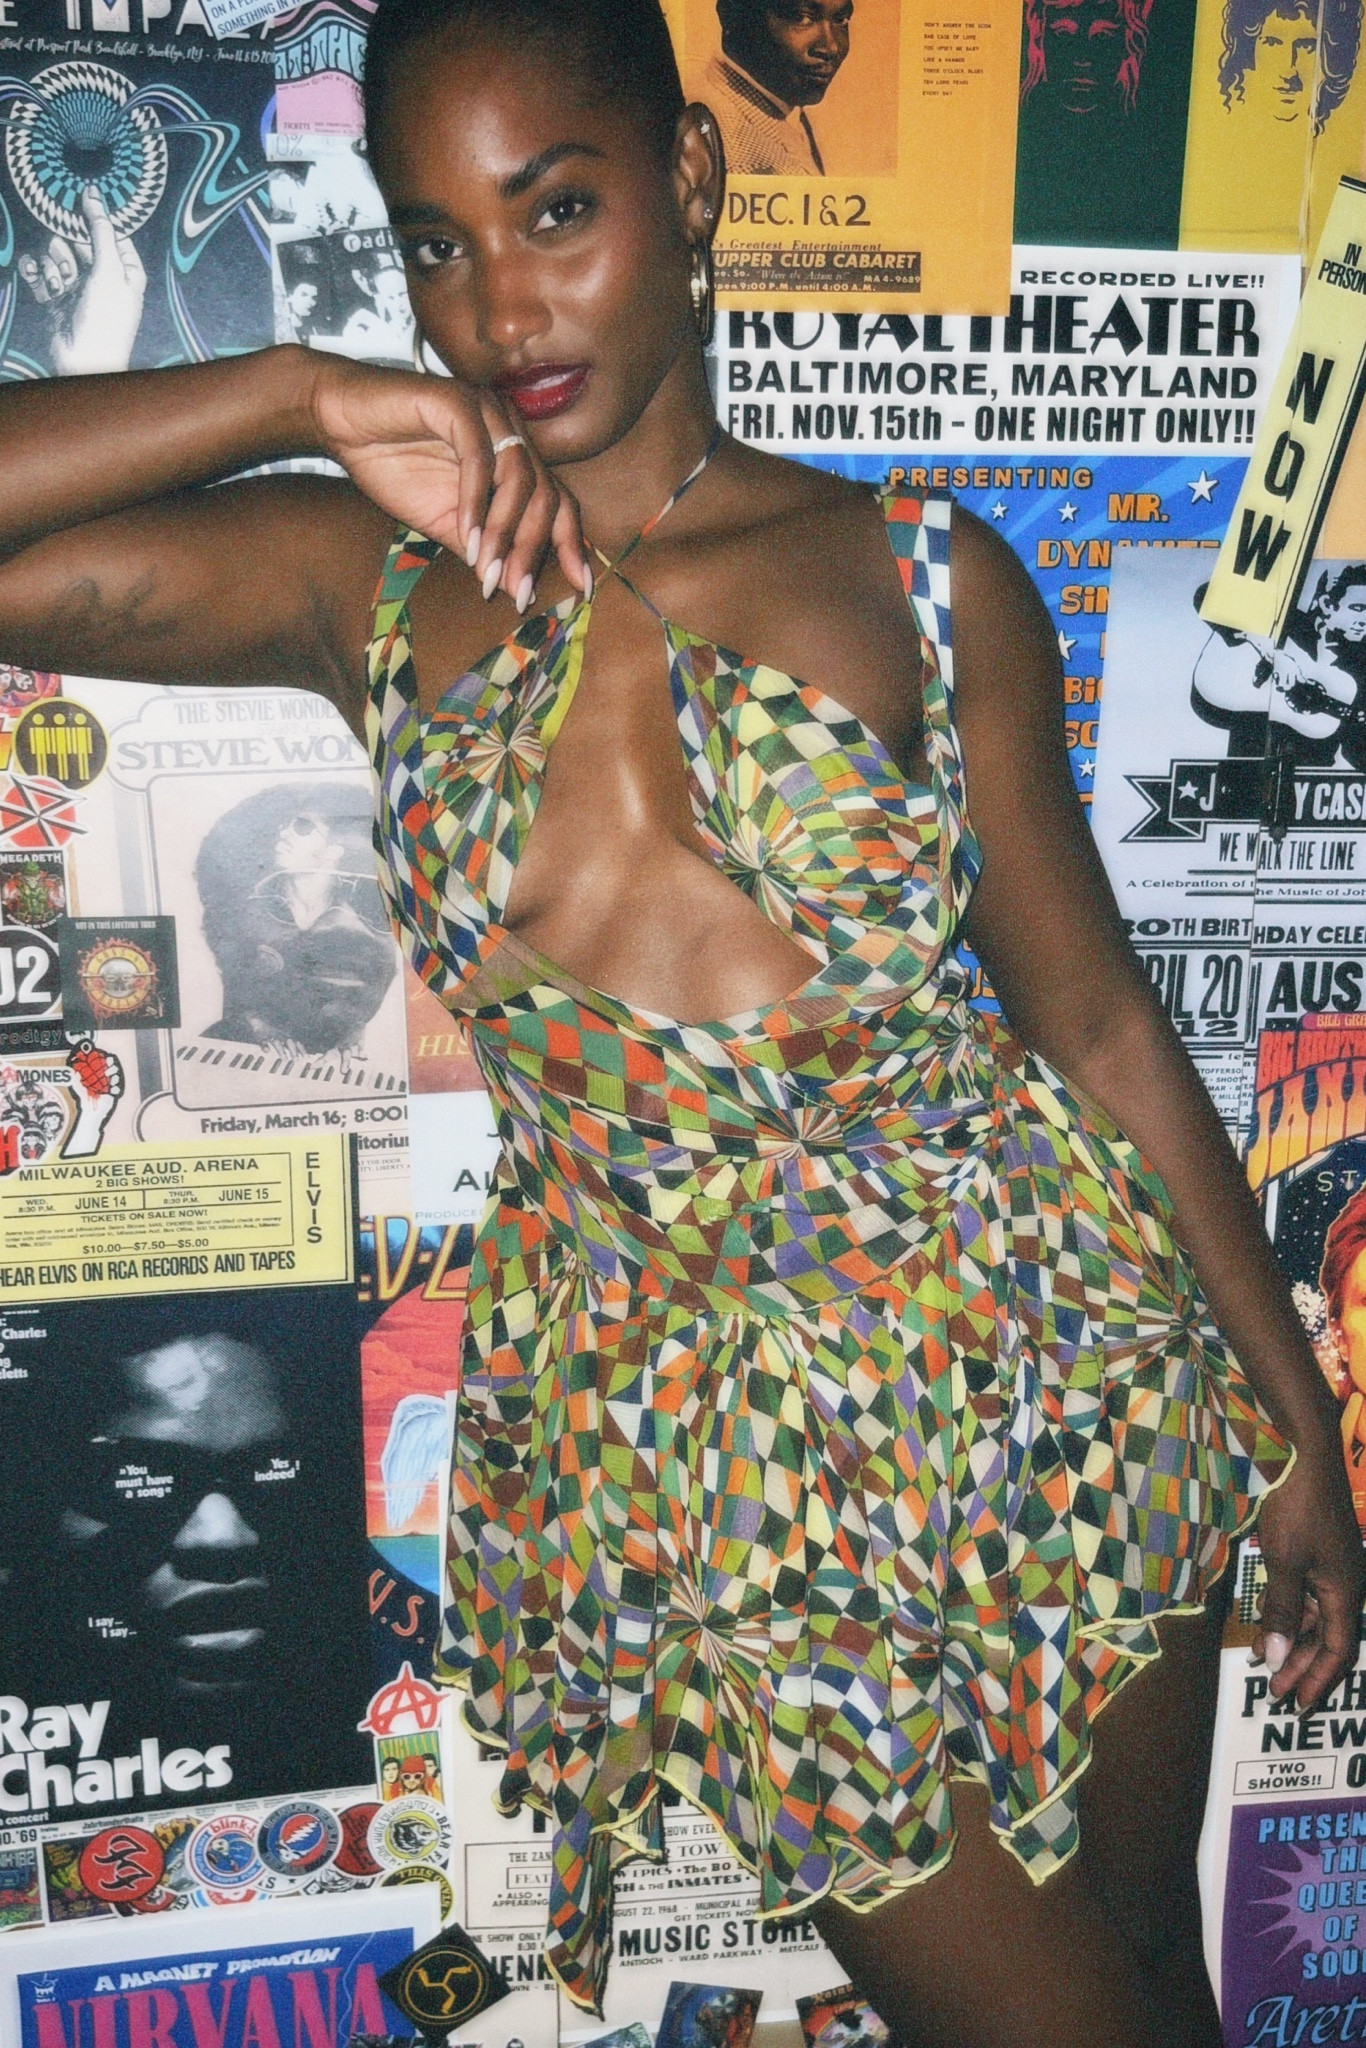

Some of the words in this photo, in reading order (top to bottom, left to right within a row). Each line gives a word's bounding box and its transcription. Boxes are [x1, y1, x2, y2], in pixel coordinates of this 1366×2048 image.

[66, 0, 275, 39] IMPA
[217, 3, 276, 35] SOMETHING
[728, 192, 794, 226] DEC.
[803, 194, 810, 226] 1
[819, 194, 840, 226] &
[845, 194, 871, 226] 2
[730, 239, 783, 250] Greatest
[792, 240, 882, 252] Entertainment
[1343, 242, 1363, 267] IN
[715, 252, 773, 268] UPPER
[780, 252, 826, 268] CLUB
[833, 253, 917, 269] CABARET
[714, 283, 738, 291] pen
[740, 282, 766, 291] 9:00
[768, 283, 794, 292] P.M.
[795, 282, 820, 291] until
[822, 283, 849, 292] 4:00
[851, 283, 876, 292] A.M.
[1020, 270, 1176, 287] RECORDED
[1187, 273, 1265, 289] LIVE!!
[969, 293, 1260, 358] THEATER
[729, 359, 998, 401] BALTIMORE,
[1011, 363, 1257, 399] MARYLAND
[728, 403, 784, 440] FRI.
[792, 404, 864, 440] NOV.
[869, 404, 942, 441] 15th
[974, 404, 1036, 442] ONE
[1046, 406, 1146, 443] NIGHT
[1155, 407, 1256, 444] ONLY!!
[889, 465, 1093, 489] PRESENTING
[1231, 350, 1336, 583] NOW
[1107, 492, 1170, 523] MR.
[174, 702, 210, 725] THE
[216, 699, 275, 723] STEVIE
[279, 697, 340, 721] WONDE
[256, 722, 321, 737] STARRING
[116, 737, 270, 771] STEVIE
[1218, 832, 1241, 862] WE
[1288, 840, 1316, 871] THE
[1320, 840, 1357, 871] LINE
[1126, 880, 1137, 888] A
[1142, 879, 1228, 888] Celebration
[1232, 879, 1246, 888] of
[1277, 888, 1322, 896] Music
[1327, 888, 1340, 896] of
[1199, 953, 1243, 1020] 20
[201, 1118, 262, 1133] Friday,
[265, 1111, 320, 1130] March
[322, 1110, 347, 1128] 16;
[354, 1105, 402, 1123] 8:00
[19, 1163, 137, 1182] MILWAUKEE
[142, 1161, 188, 1175] AUD.
[193, 1158, 259, 1173] ARENA
[95, 1180, 103, 1189] 2
[107, 1178, 129, 1188] BIG
[132, 1174, 185, 1187] SHOWS!
[75, 1196, 109, 1210] JUNE
[113, 1196, 127, 1208] 14
[218, 1189, 252, 1202] JUNE
[256, 1188, 269, 1200] 15
[305, 1151, 323, 1244] ELVIS
[81, 1213, 126, 1223] TICKETS
[129, 1212, 145, 1221] ON
[147, 1210, 176, 1220] SALE
[178, 1209, 208, 1218] NOW!
[39, 1264, 77, 1285] ELVIS
[82, 1261, 103, 1283] ON
[108, 1259, 138, 1281] RCA
[142, 1255, 208, 1278] RECORDS
[213, 1252, 245, 1274] AND
[250, 1250, 296, 1272] TAPES
[1, 1327, 47, 1340] Charles
[270, 1458, 290, 1470] Yes
[115, 1478, 143, 1489] must
[146, 1474, 174, 1486] have
[125, 1489, 133, 1498] a
[0, 1695, 111, 1759] Ray
[1260, 1717, 1366, 1753] NEW
[0, 1737, 233, 1812] Charles
[1267, 1762, 1306, 1775] TWO
[1247, 1774, 1322, 1790] SHOWS!!
[5, 1812, 49, 1826] concert
[509, 1852, 527, 1863] THE
[667, 1874, 742, 1889] INMATES
[492, 1899, 549, 1908] APPEARING
[507, 1891, 533, 1900] ALSO
[694, 1899, 742, 1912] MUNICIPAL
[673, 1914, 693, 1923] GET
[696, 1911, 732, 1922] TICKETS
[487, 1933, 514, 1943] SHOW
[518, 1931, 541, 1942] ONLY
[1323, 1914, 1359, 1943] OF
[618, 1923, 711, 1958] MUSIC
[678, 1953, 709, 1963] WARD
[713, 1948, 763, 1960] PARKWAY
[779, 1943, 821, 1955] METCALF
[95, 1974, 116, 1992] A
[119, 1962, 219, 1990] MAGNET
[226, 1946, 342, 1975] PROMOTION
[32, 1962, 388, 2048] NIRVANA
